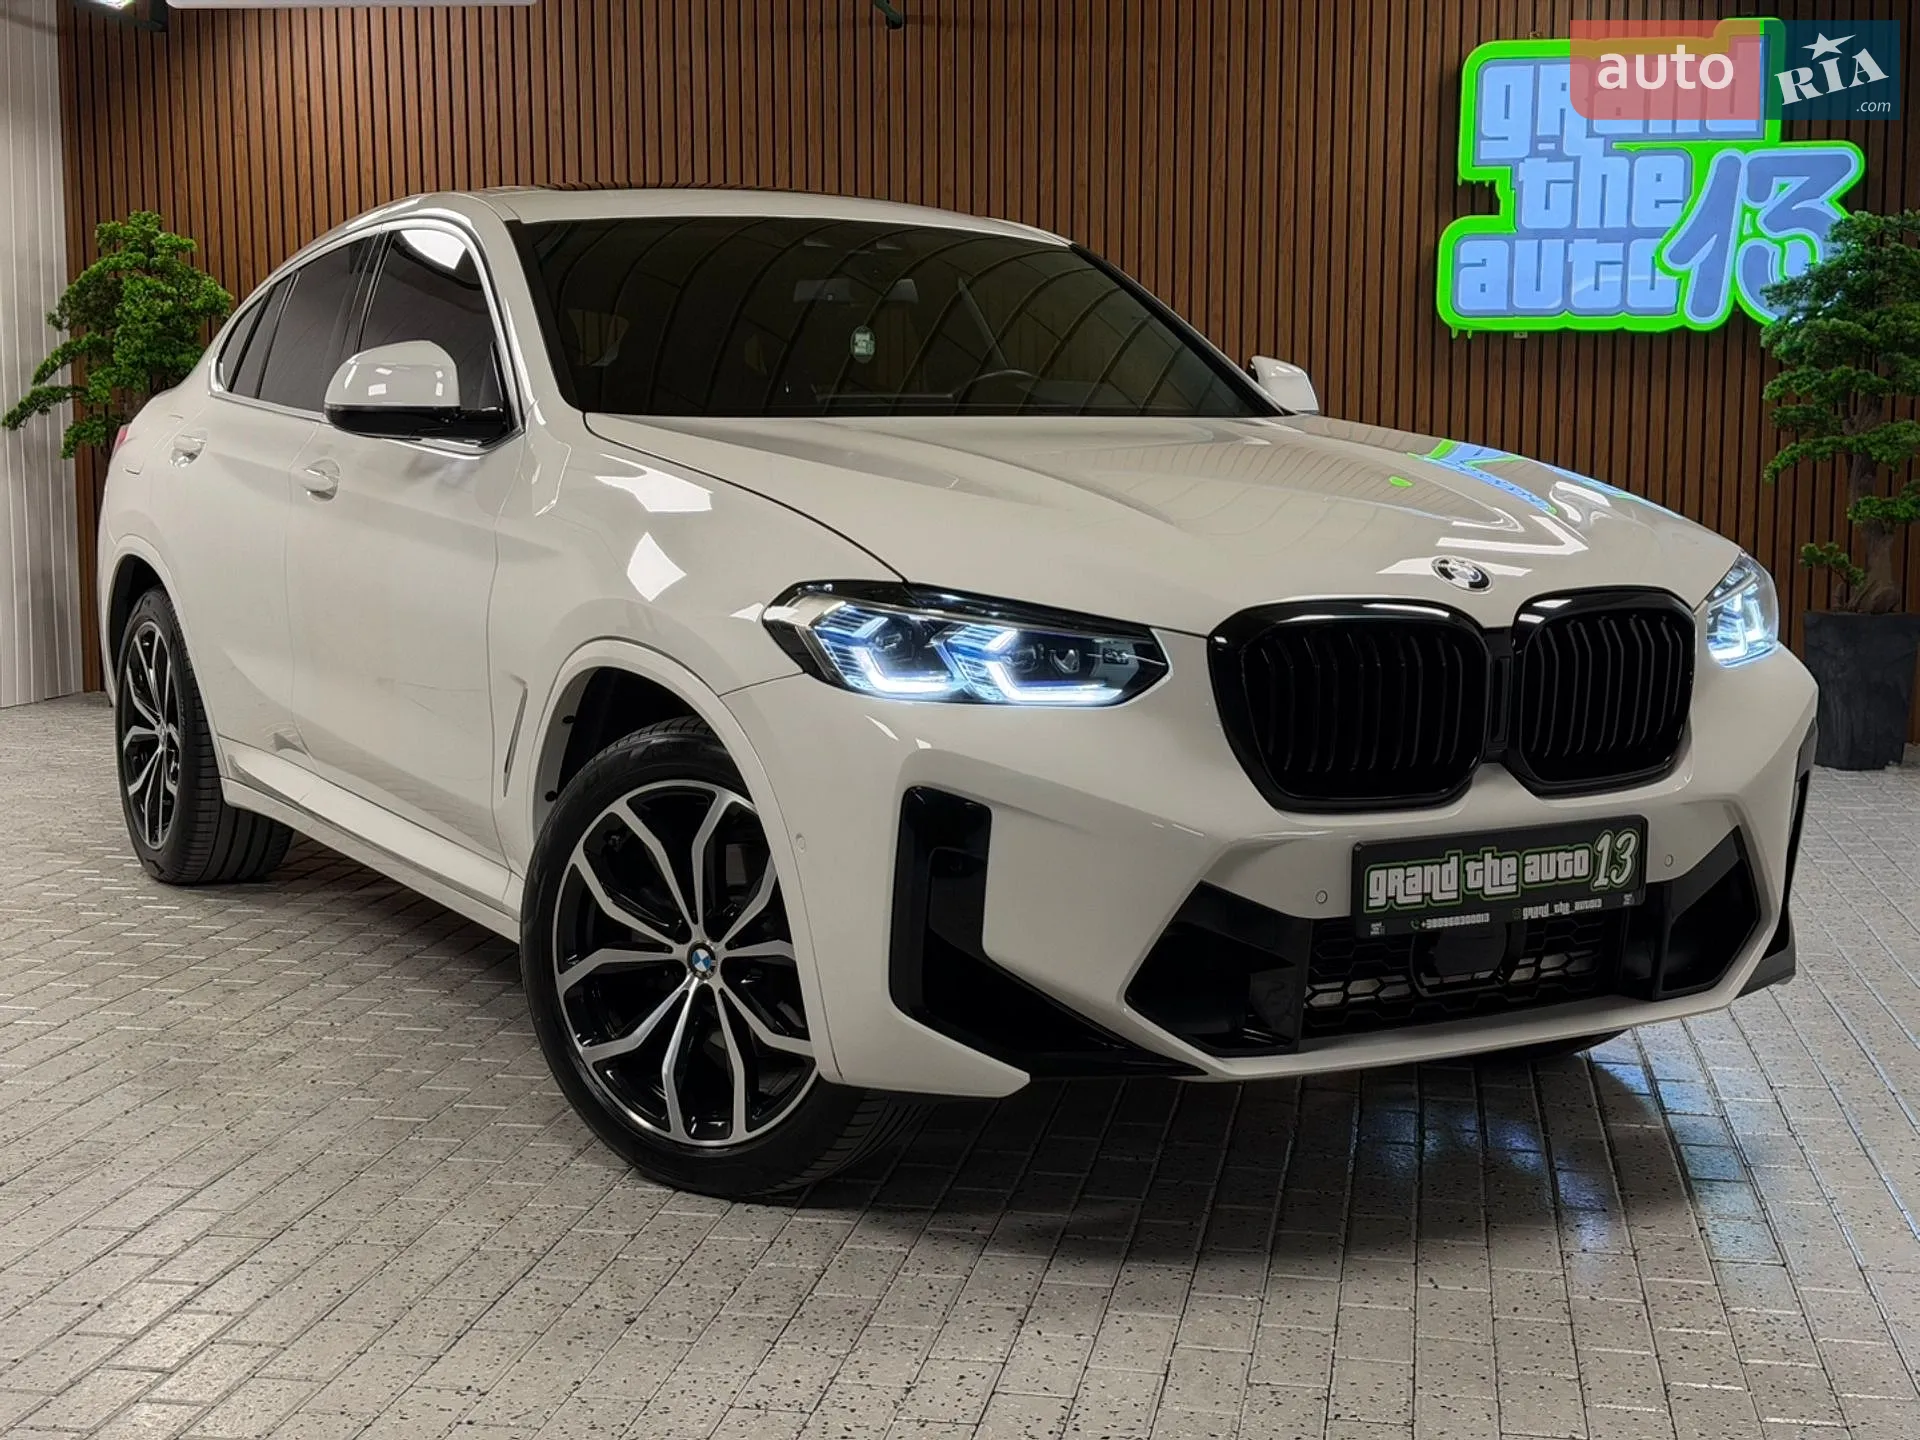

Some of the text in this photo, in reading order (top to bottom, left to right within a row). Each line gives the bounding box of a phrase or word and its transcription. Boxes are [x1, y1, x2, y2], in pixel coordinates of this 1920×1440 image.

[1519, 138, 1686, 228] the
[1457, 237, 1682, 312] auto
[1662, 149, 1858, 325] 13
[1368, 831, 1637, 907] grand the auto 13
